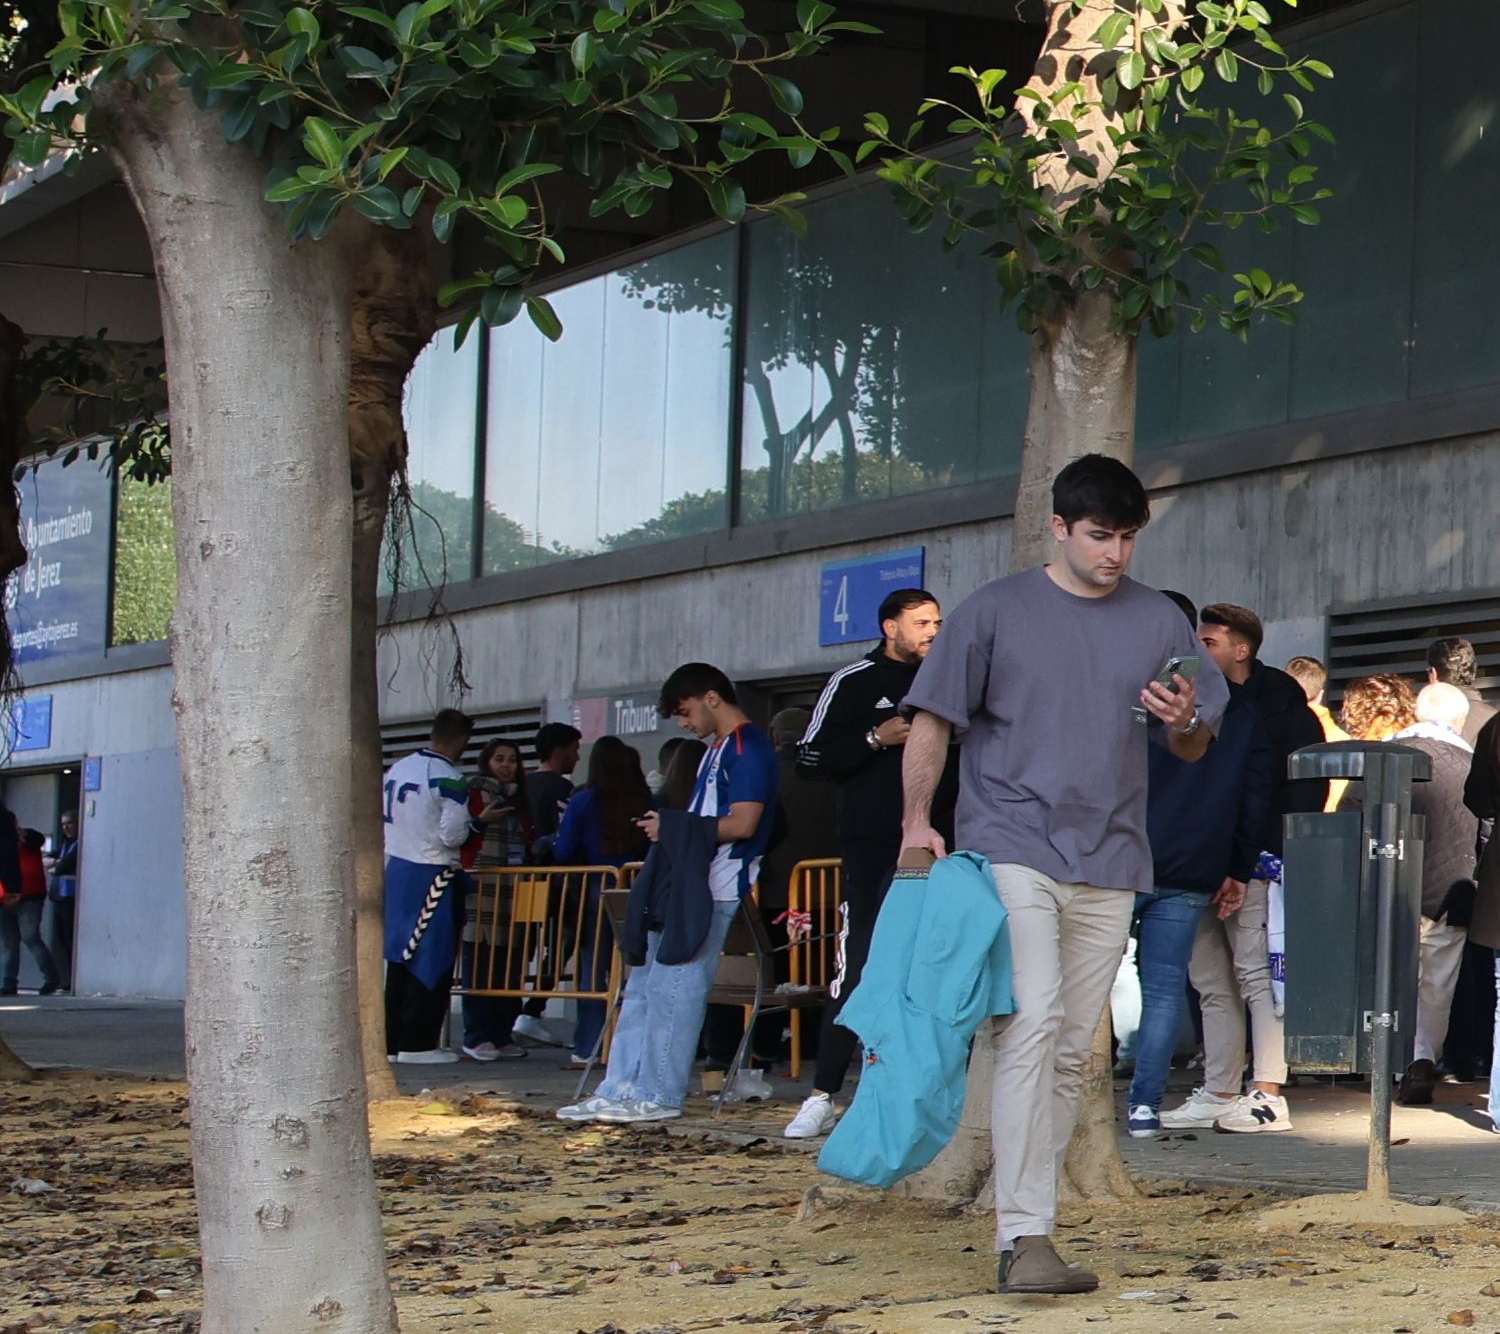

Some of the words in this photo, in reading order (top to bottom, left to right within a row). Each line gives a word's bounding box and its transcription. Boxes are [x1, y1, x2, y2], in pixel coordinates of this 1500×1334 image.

[26, 505, 92, 549] Ayuntamiento
[24, 559, 37, 594] de
[37, 556, 62, 598] Jerez
[833, 575, 849, 636] 4
[614, 699, 658, 735] Tribuna
